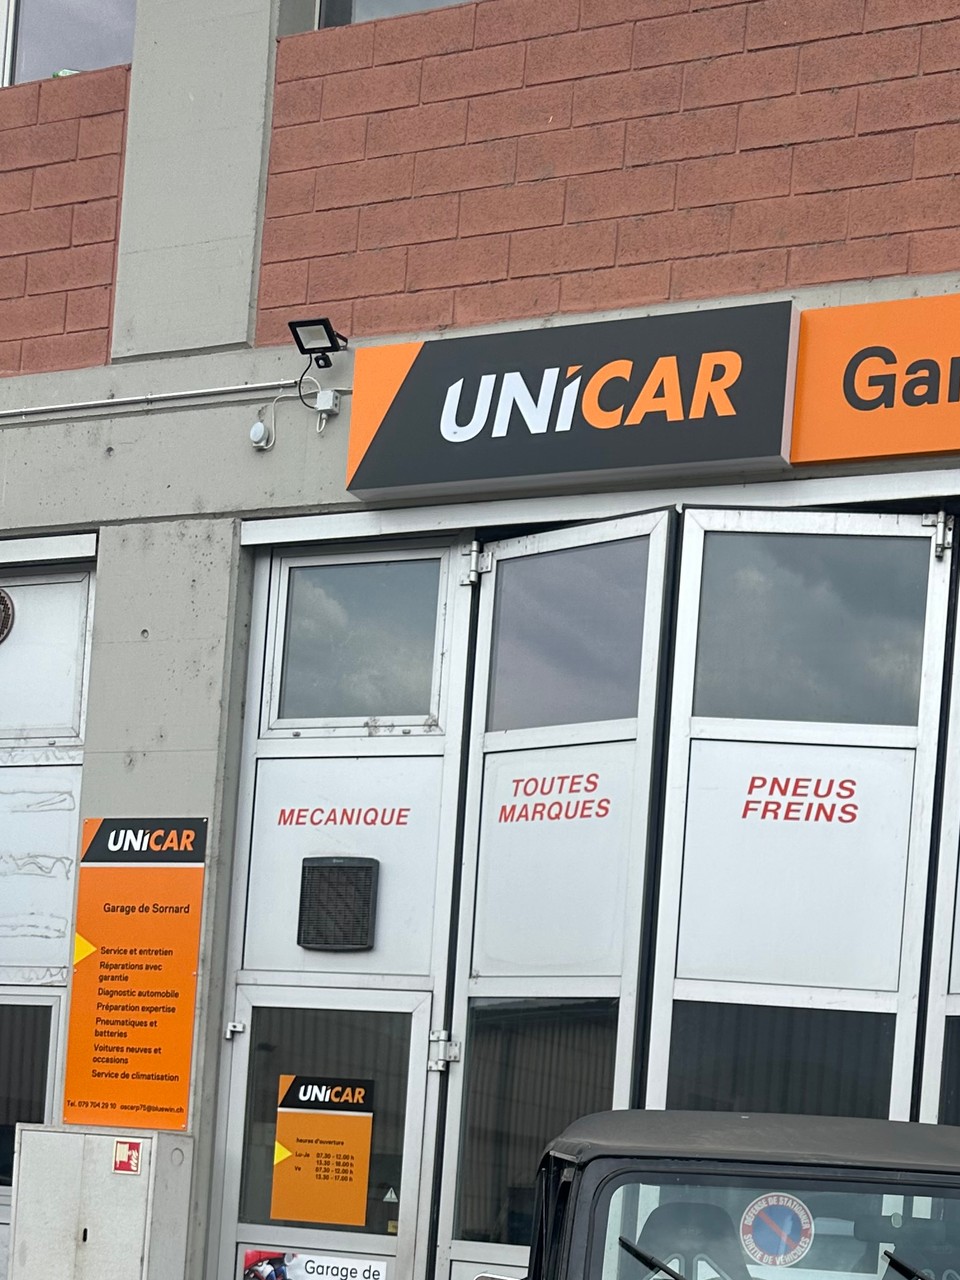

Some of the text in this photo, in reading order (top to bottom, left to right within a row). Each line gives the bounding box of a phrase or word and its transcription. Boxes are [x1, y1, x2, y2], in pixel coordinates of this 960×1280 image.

[512, 773, 600, 797] TOUTES
[747, 776, 857, 798] PNEUS
[277, 807, 411, 827] MECANIQUE
[498, 798, 611, 824] MARQUES
[741, 800, 859, 824] FREINS
[103, 903, 190, 915] Garage de Sornard
[100, 946, 128, 955] Service
[138, 948, 174, 956] entretien
[99, 961, 144, 971] Réparations
[98, 974, 129, 982] garantie
[98, 988, 180, 998] Diagnostic automobile
[96, 1002, 176, 1014] Préparation expertise
[96, 1017, 148, 1028] Pneumatiques
[94, 1029, 128, 1038] batteries
[94, 1044, 124, 1052] Voitures
[92, 1056, 128, 1064] occasions
[92, 1069, 180, 1082] Service de climatisation
[768, 1196, 778, 1206] DE
[778, 1196, 810, 1230] STATIONNER
[744, 1233, 764, 1260] SORTIE
[762, 1255, 774, 1265] DE
[362, 1264, 381, 1280] de
